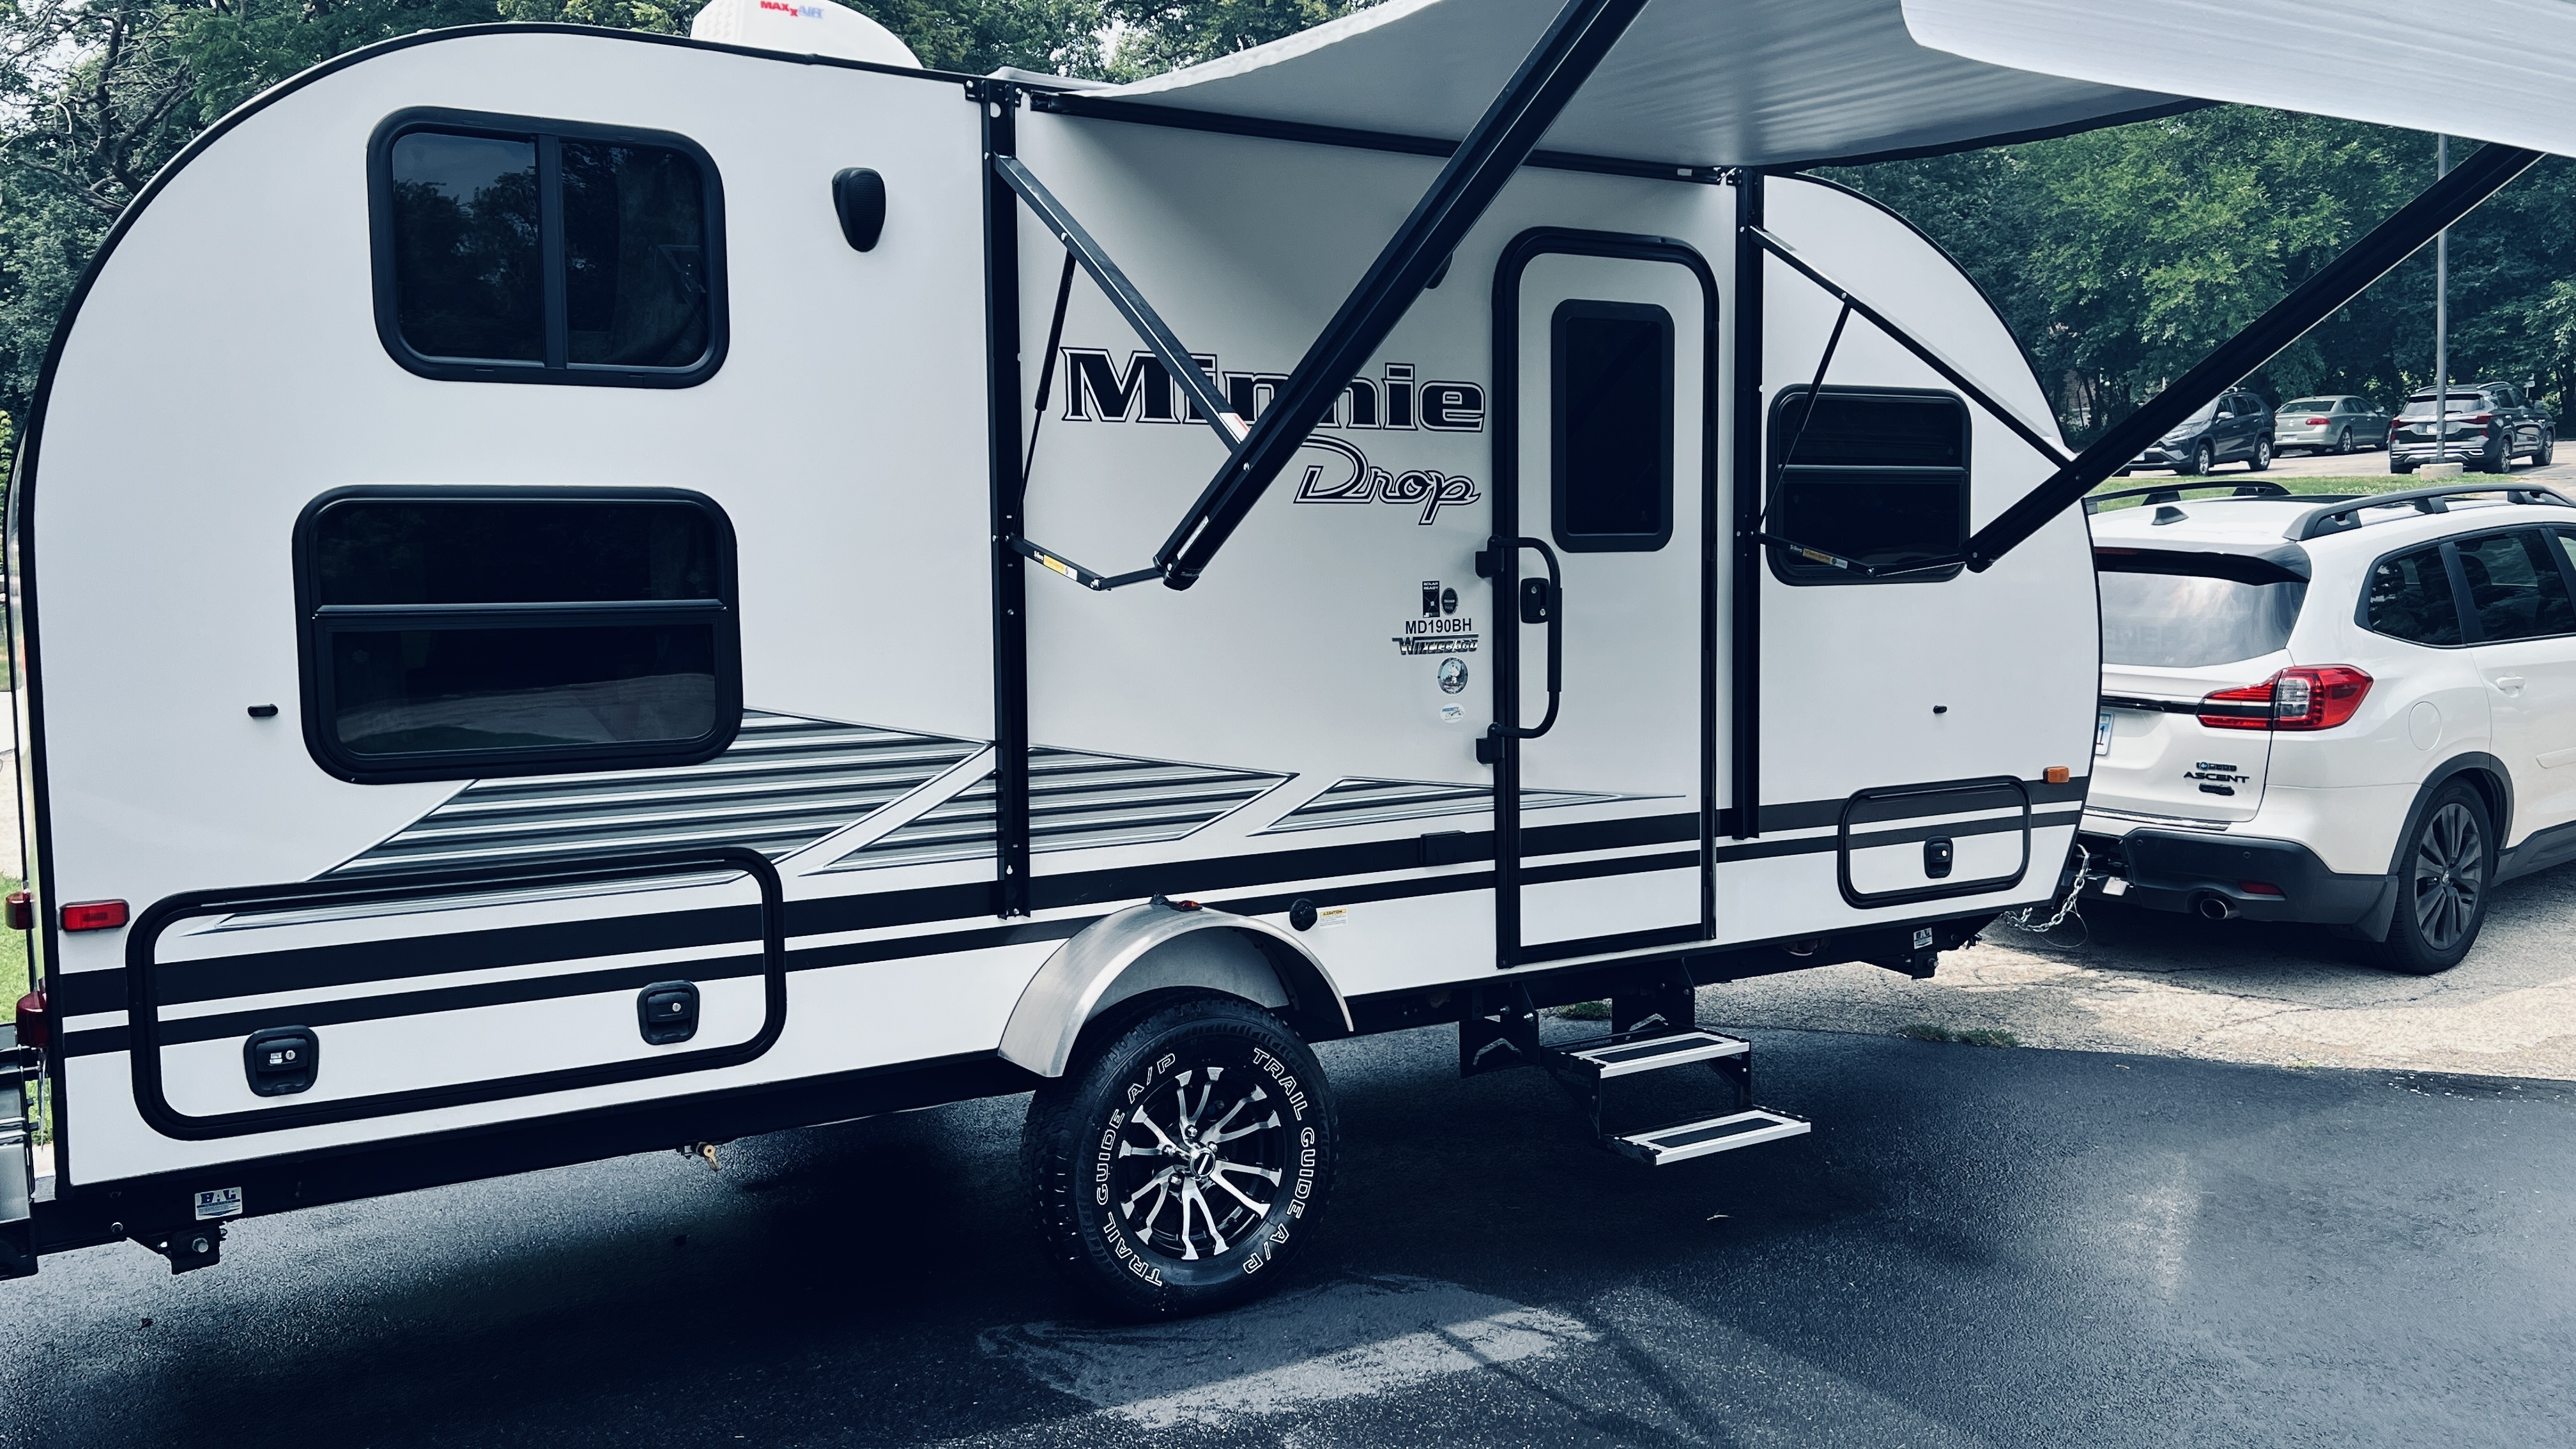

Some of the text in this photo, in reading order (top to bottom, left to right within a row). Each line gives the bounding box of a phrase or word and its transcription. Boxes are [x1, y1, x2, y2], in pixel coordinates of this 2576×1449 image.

[1293, 433, 1482, 525] Drop
[1406, 618, 1472, 634] MD190BH
[2184, 771, 2250, 783] ASCENT
[1096, 1053, 1176, 1287] TRAIL GUIDE A/P
[1243, 1047, 1315, 1274] TRAIL GUIDE A/P
